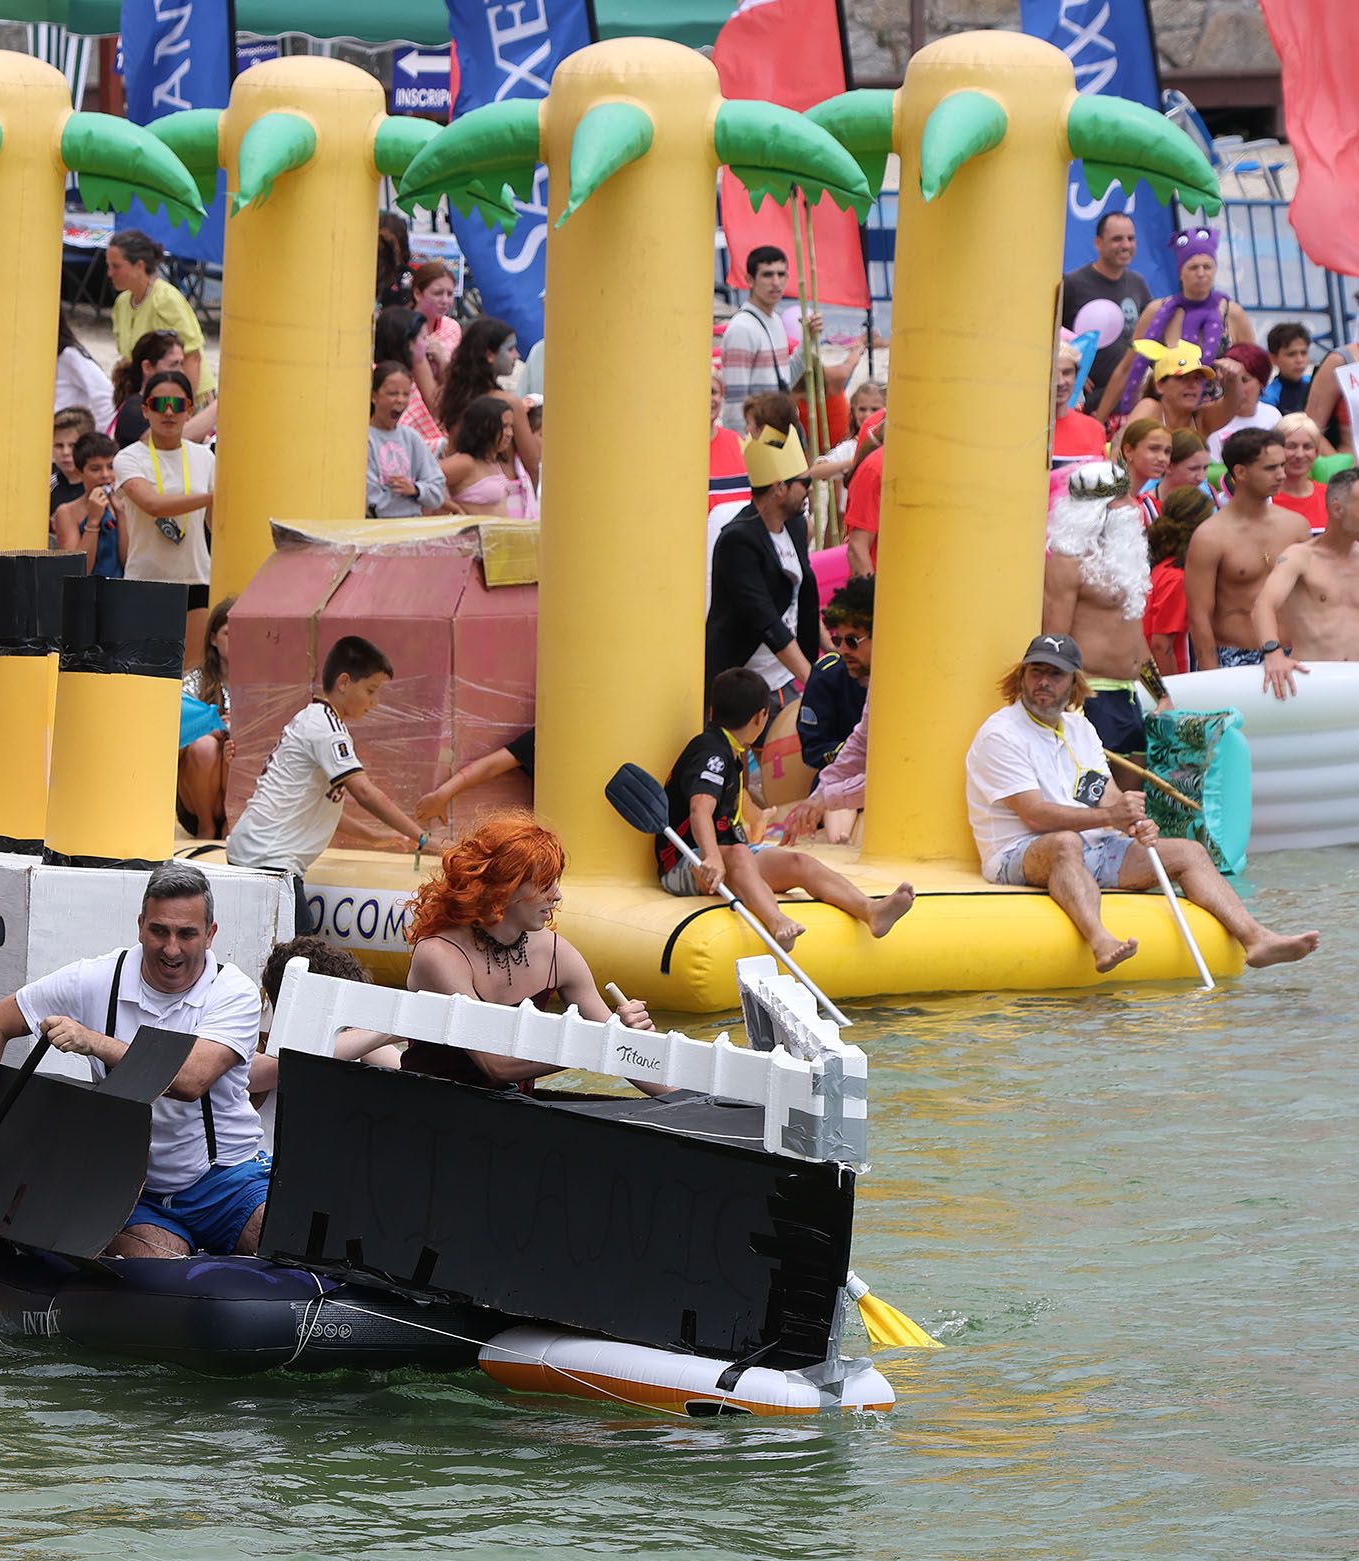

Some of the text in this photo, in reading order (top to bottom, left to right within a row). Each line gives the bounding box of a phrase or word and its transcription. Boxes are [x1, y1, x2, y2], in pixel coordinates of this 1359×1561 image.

[152, 0, 192, 109] AN
[616, 1045, 661, 1070] Titanic
[346, 1111, 755, 1301] TITANIC
